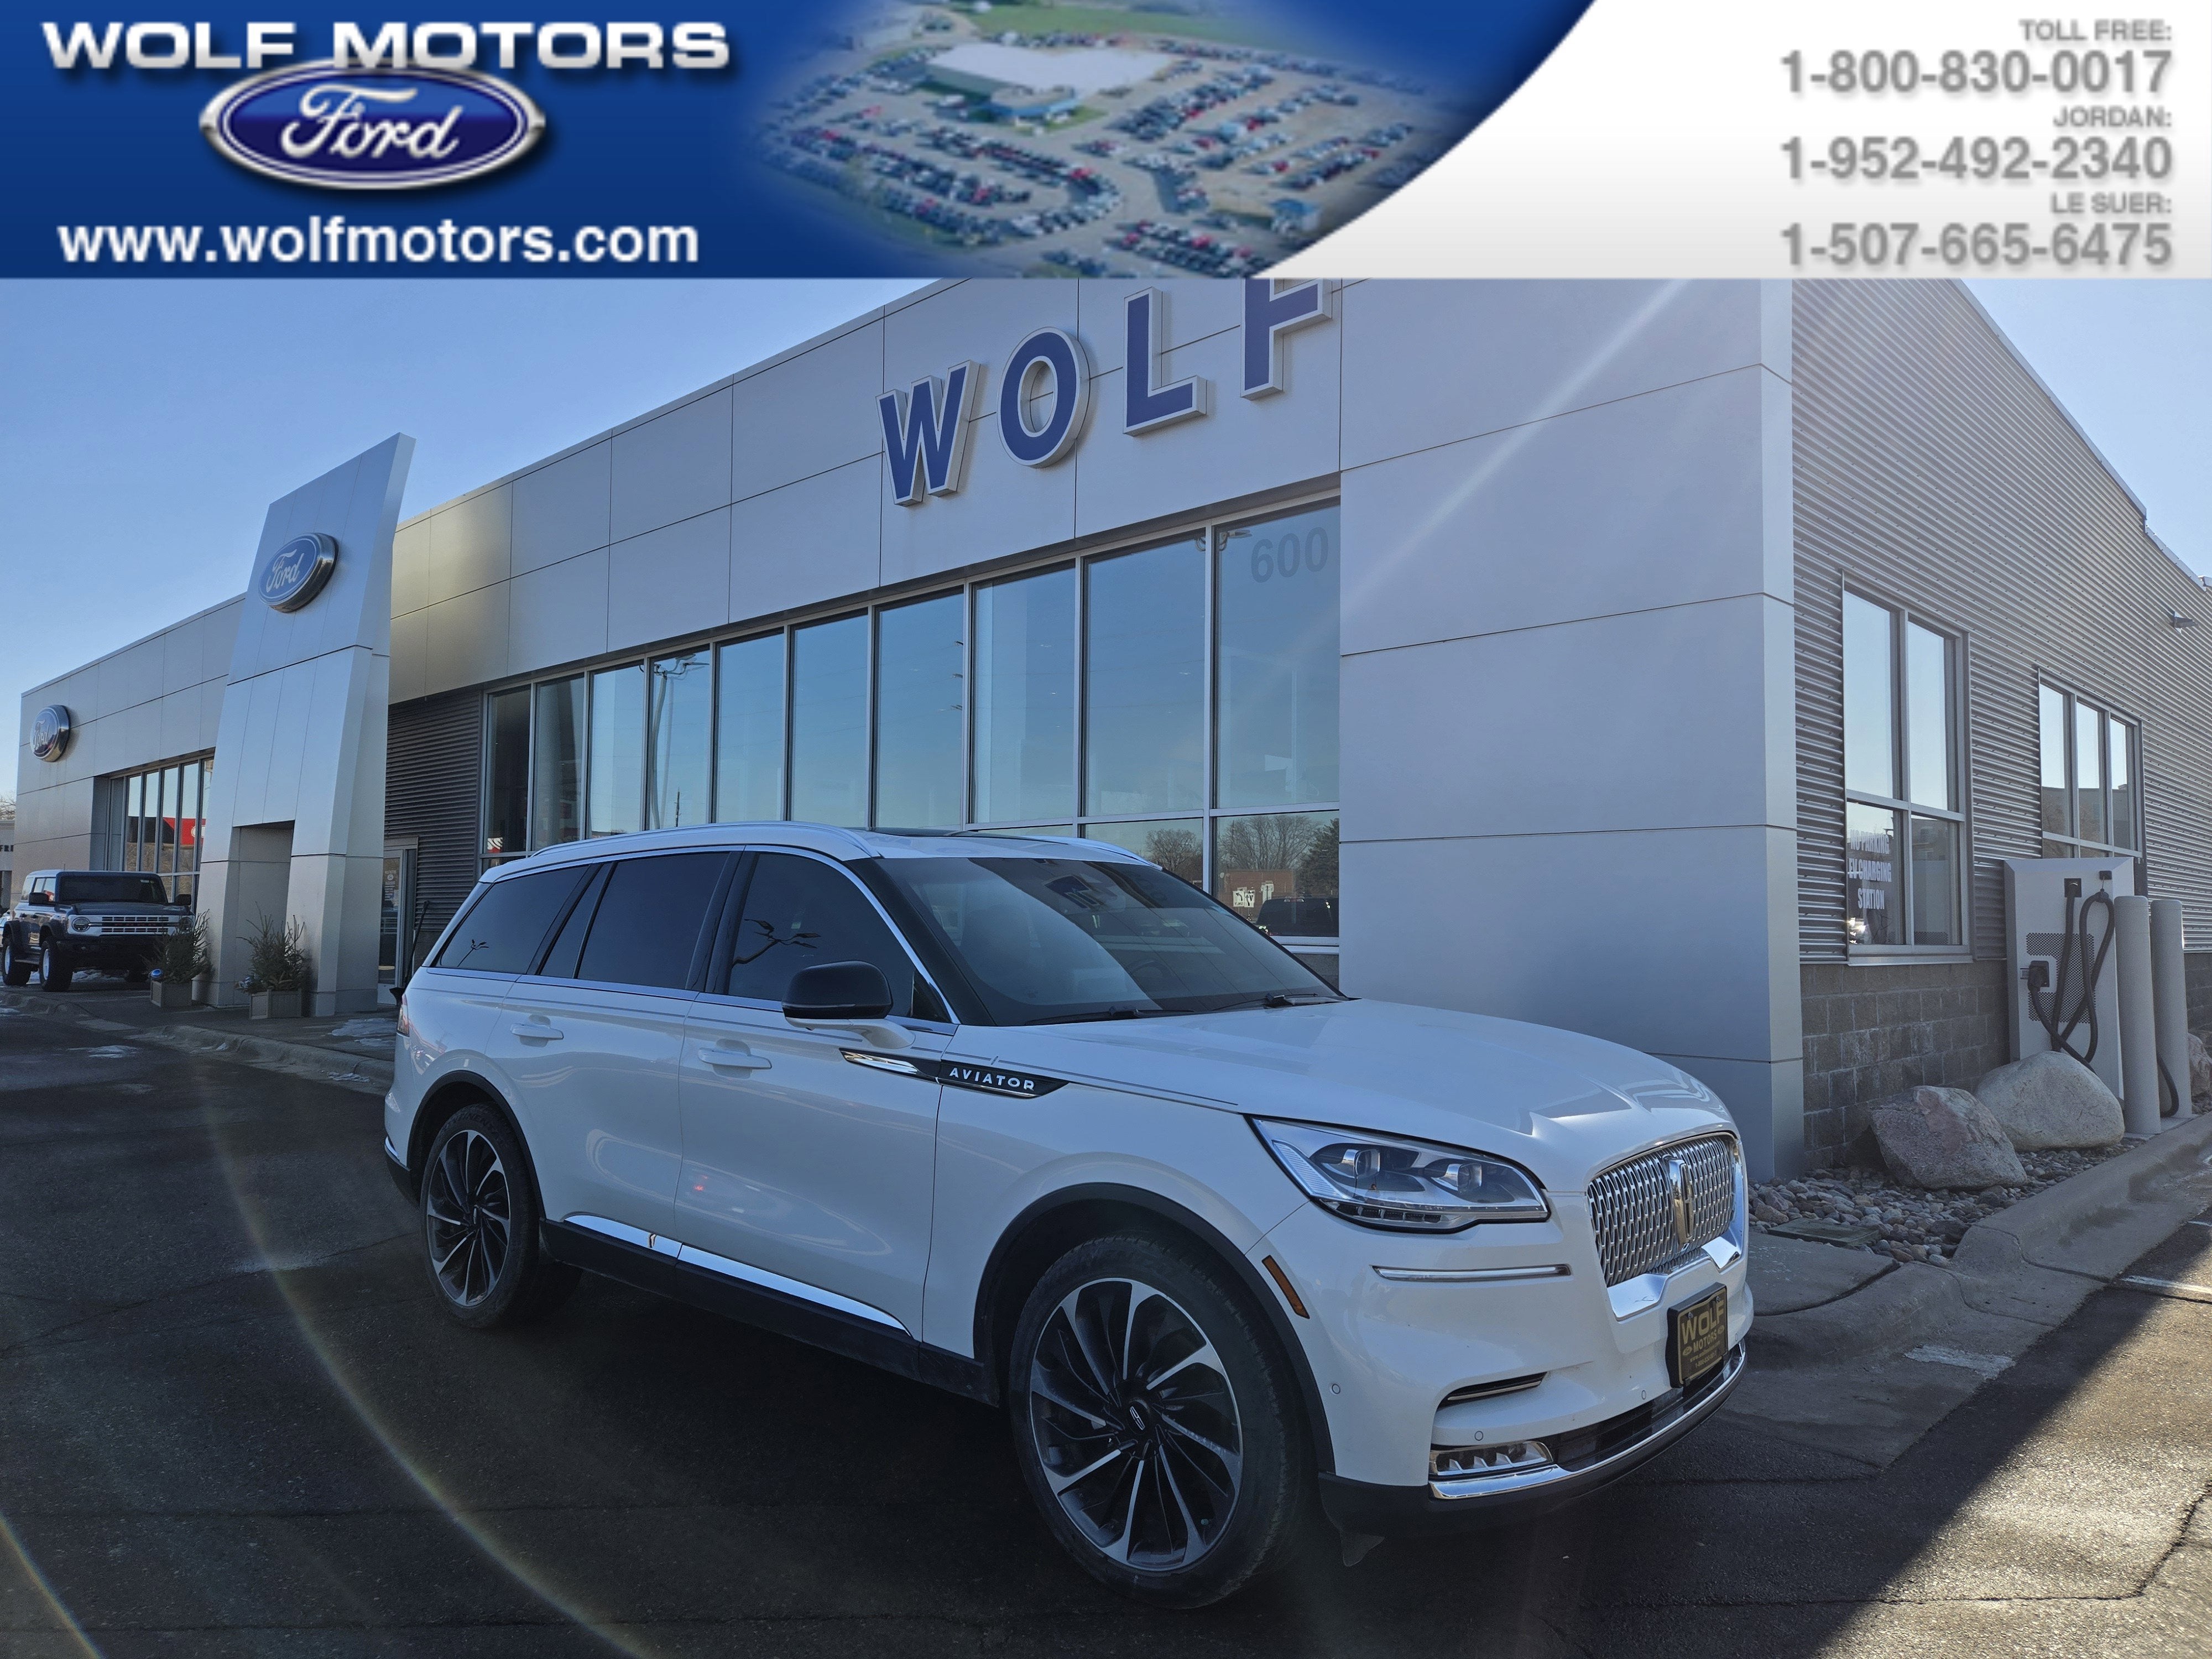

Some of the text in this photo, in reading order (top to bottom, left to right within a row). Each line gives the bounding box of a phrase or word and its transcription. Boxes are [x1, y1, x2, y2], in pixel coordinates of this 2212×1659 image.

[875, 278, 1332, 507] WOLF
[1251, 527, 1328, 583] 600
[266, 549, 304, 592] Ford
[1850, 829, 1890, 855] NO PARKING
[1849, 858, 1892, 882] EV CHARGING
[1858, 888, 1885, 910] STATION
[949, 1067, 1035, 1091] AVIATOR
[1681, 1300, 1724, 1345] WOLF
[1693, 1330, 1717, 1353] MOTORS
